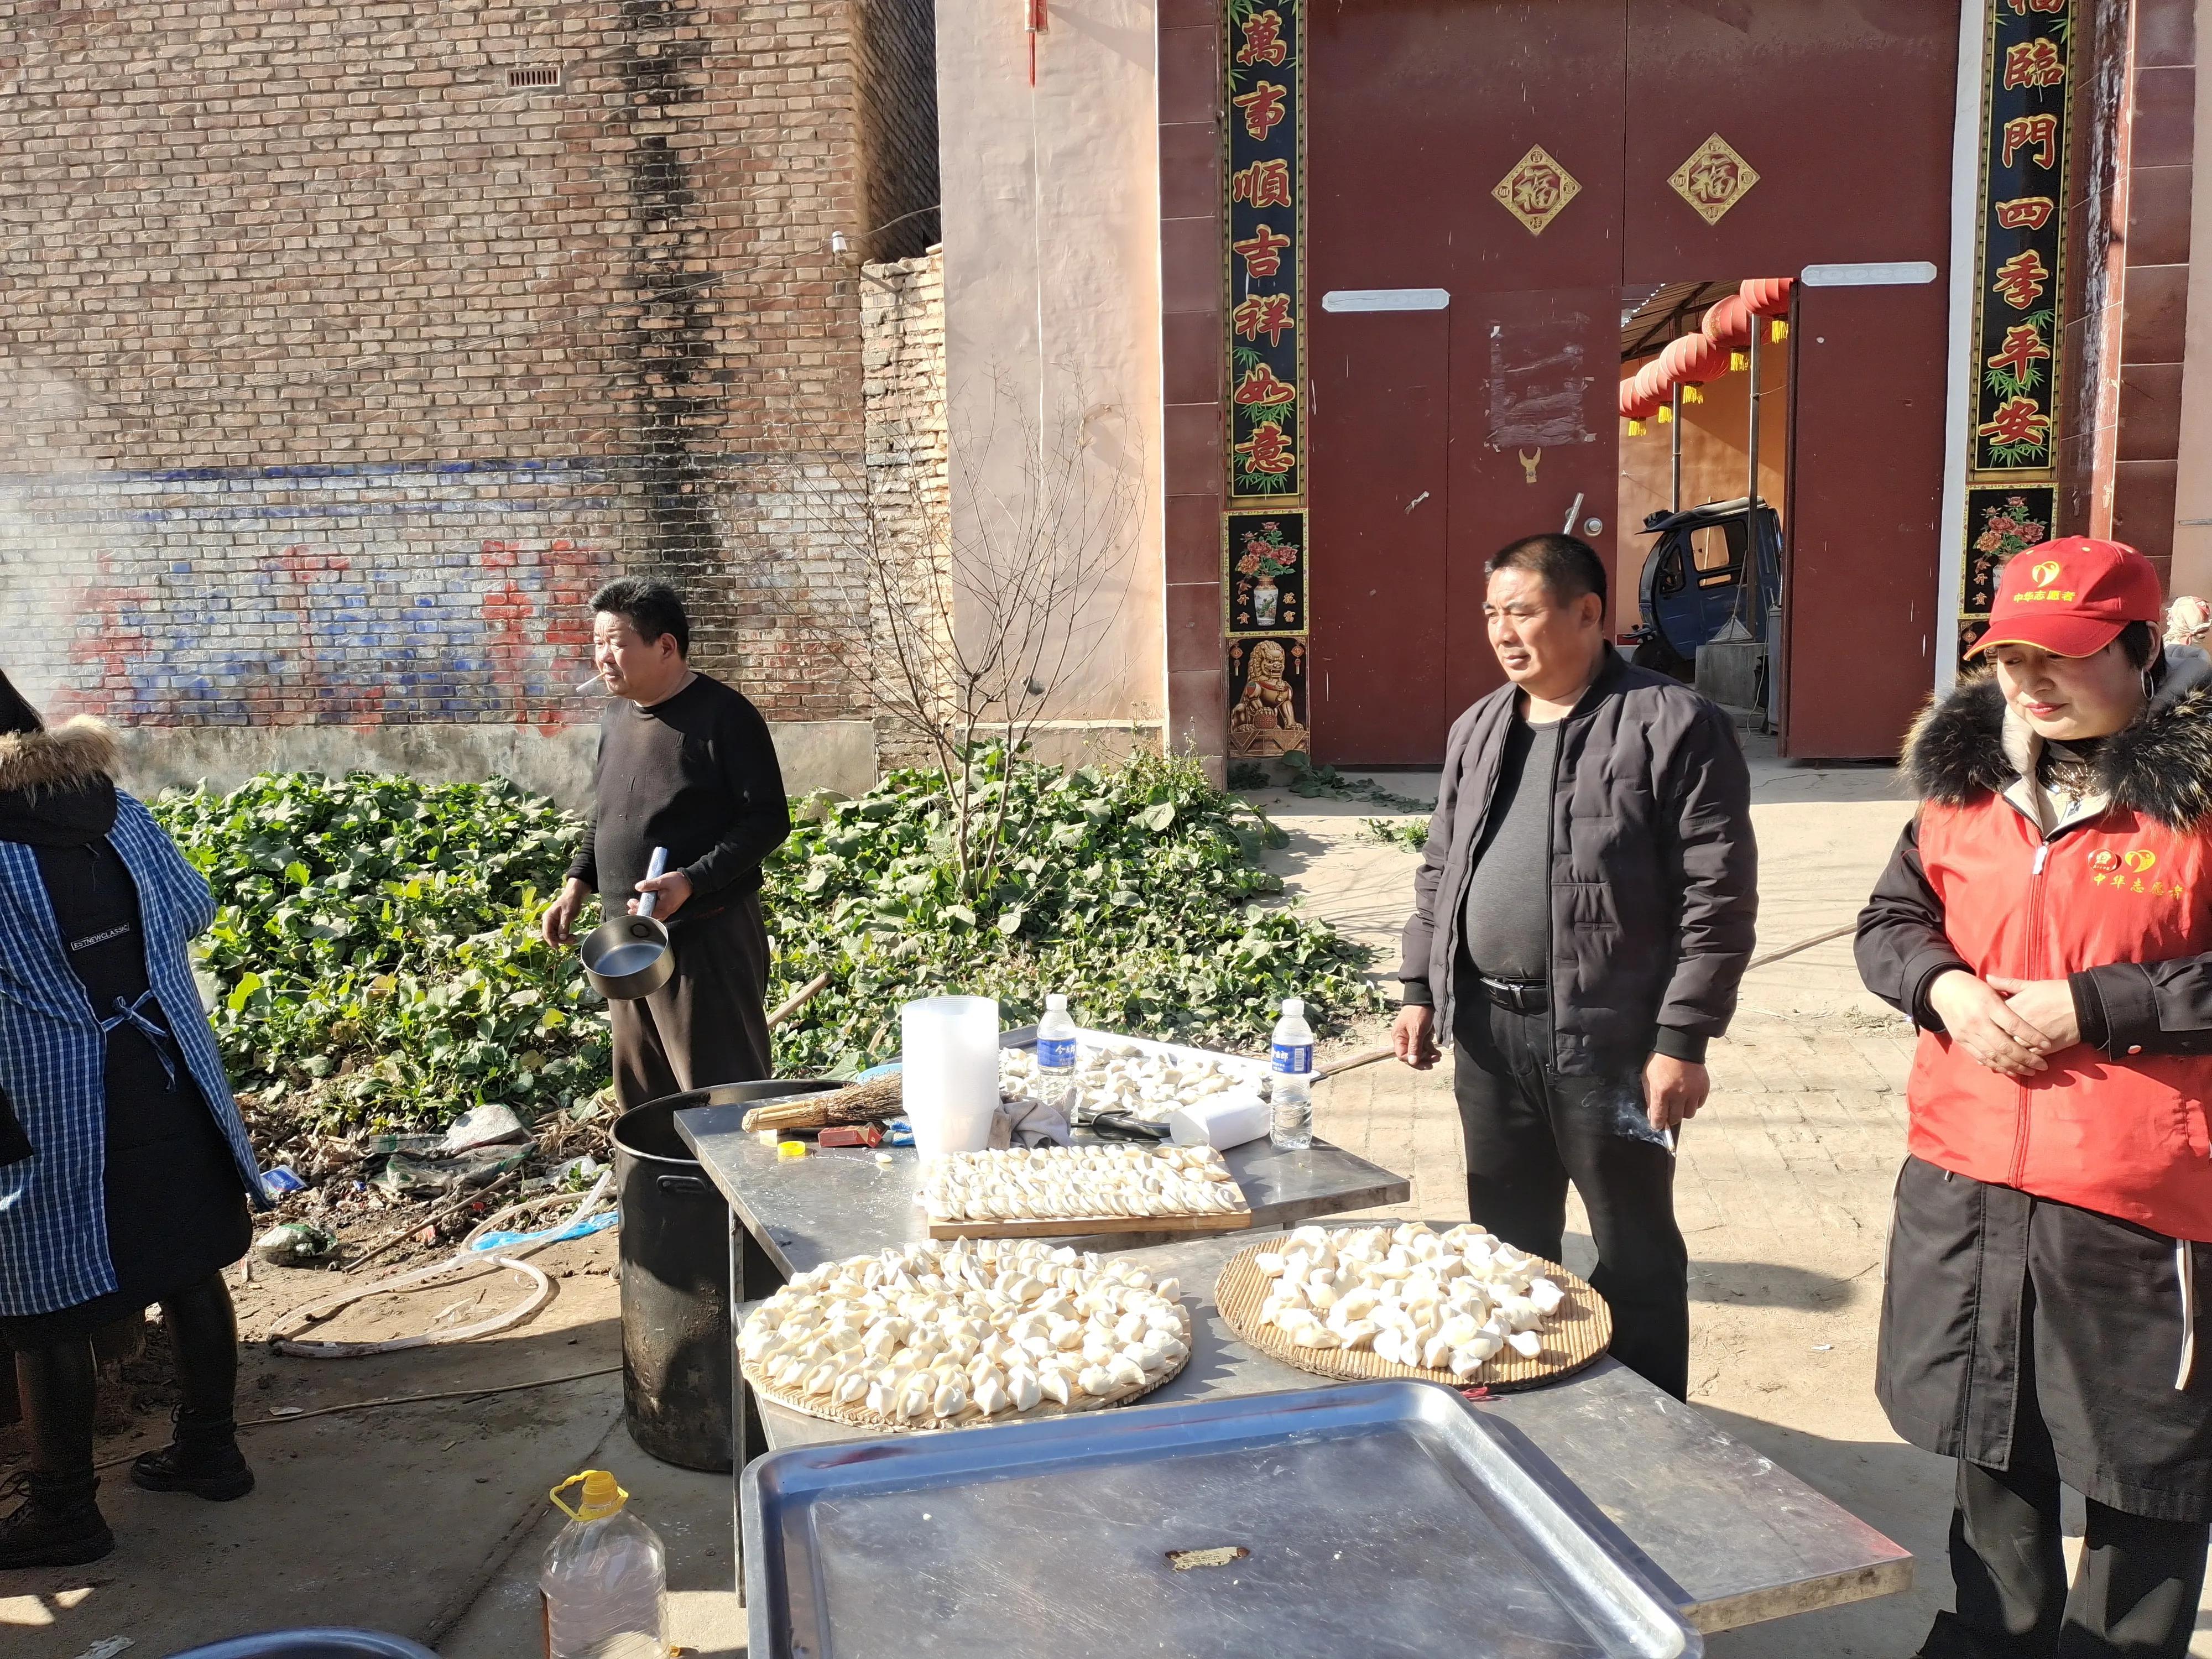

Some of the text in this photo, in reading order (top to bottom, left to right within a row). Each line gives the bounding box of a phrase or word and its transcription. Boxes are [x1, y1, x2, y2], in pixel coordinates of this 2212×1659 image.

[1514, 166, 1559, 212] 福
[1691, 155, 1736, 201] 福
[1233, 9, 1296, 473] 萬事順吉祥如意
[2013, 589, 2076, 603] 中华志愿者
[2093, 873, 2184, 899] 中华志愿者
